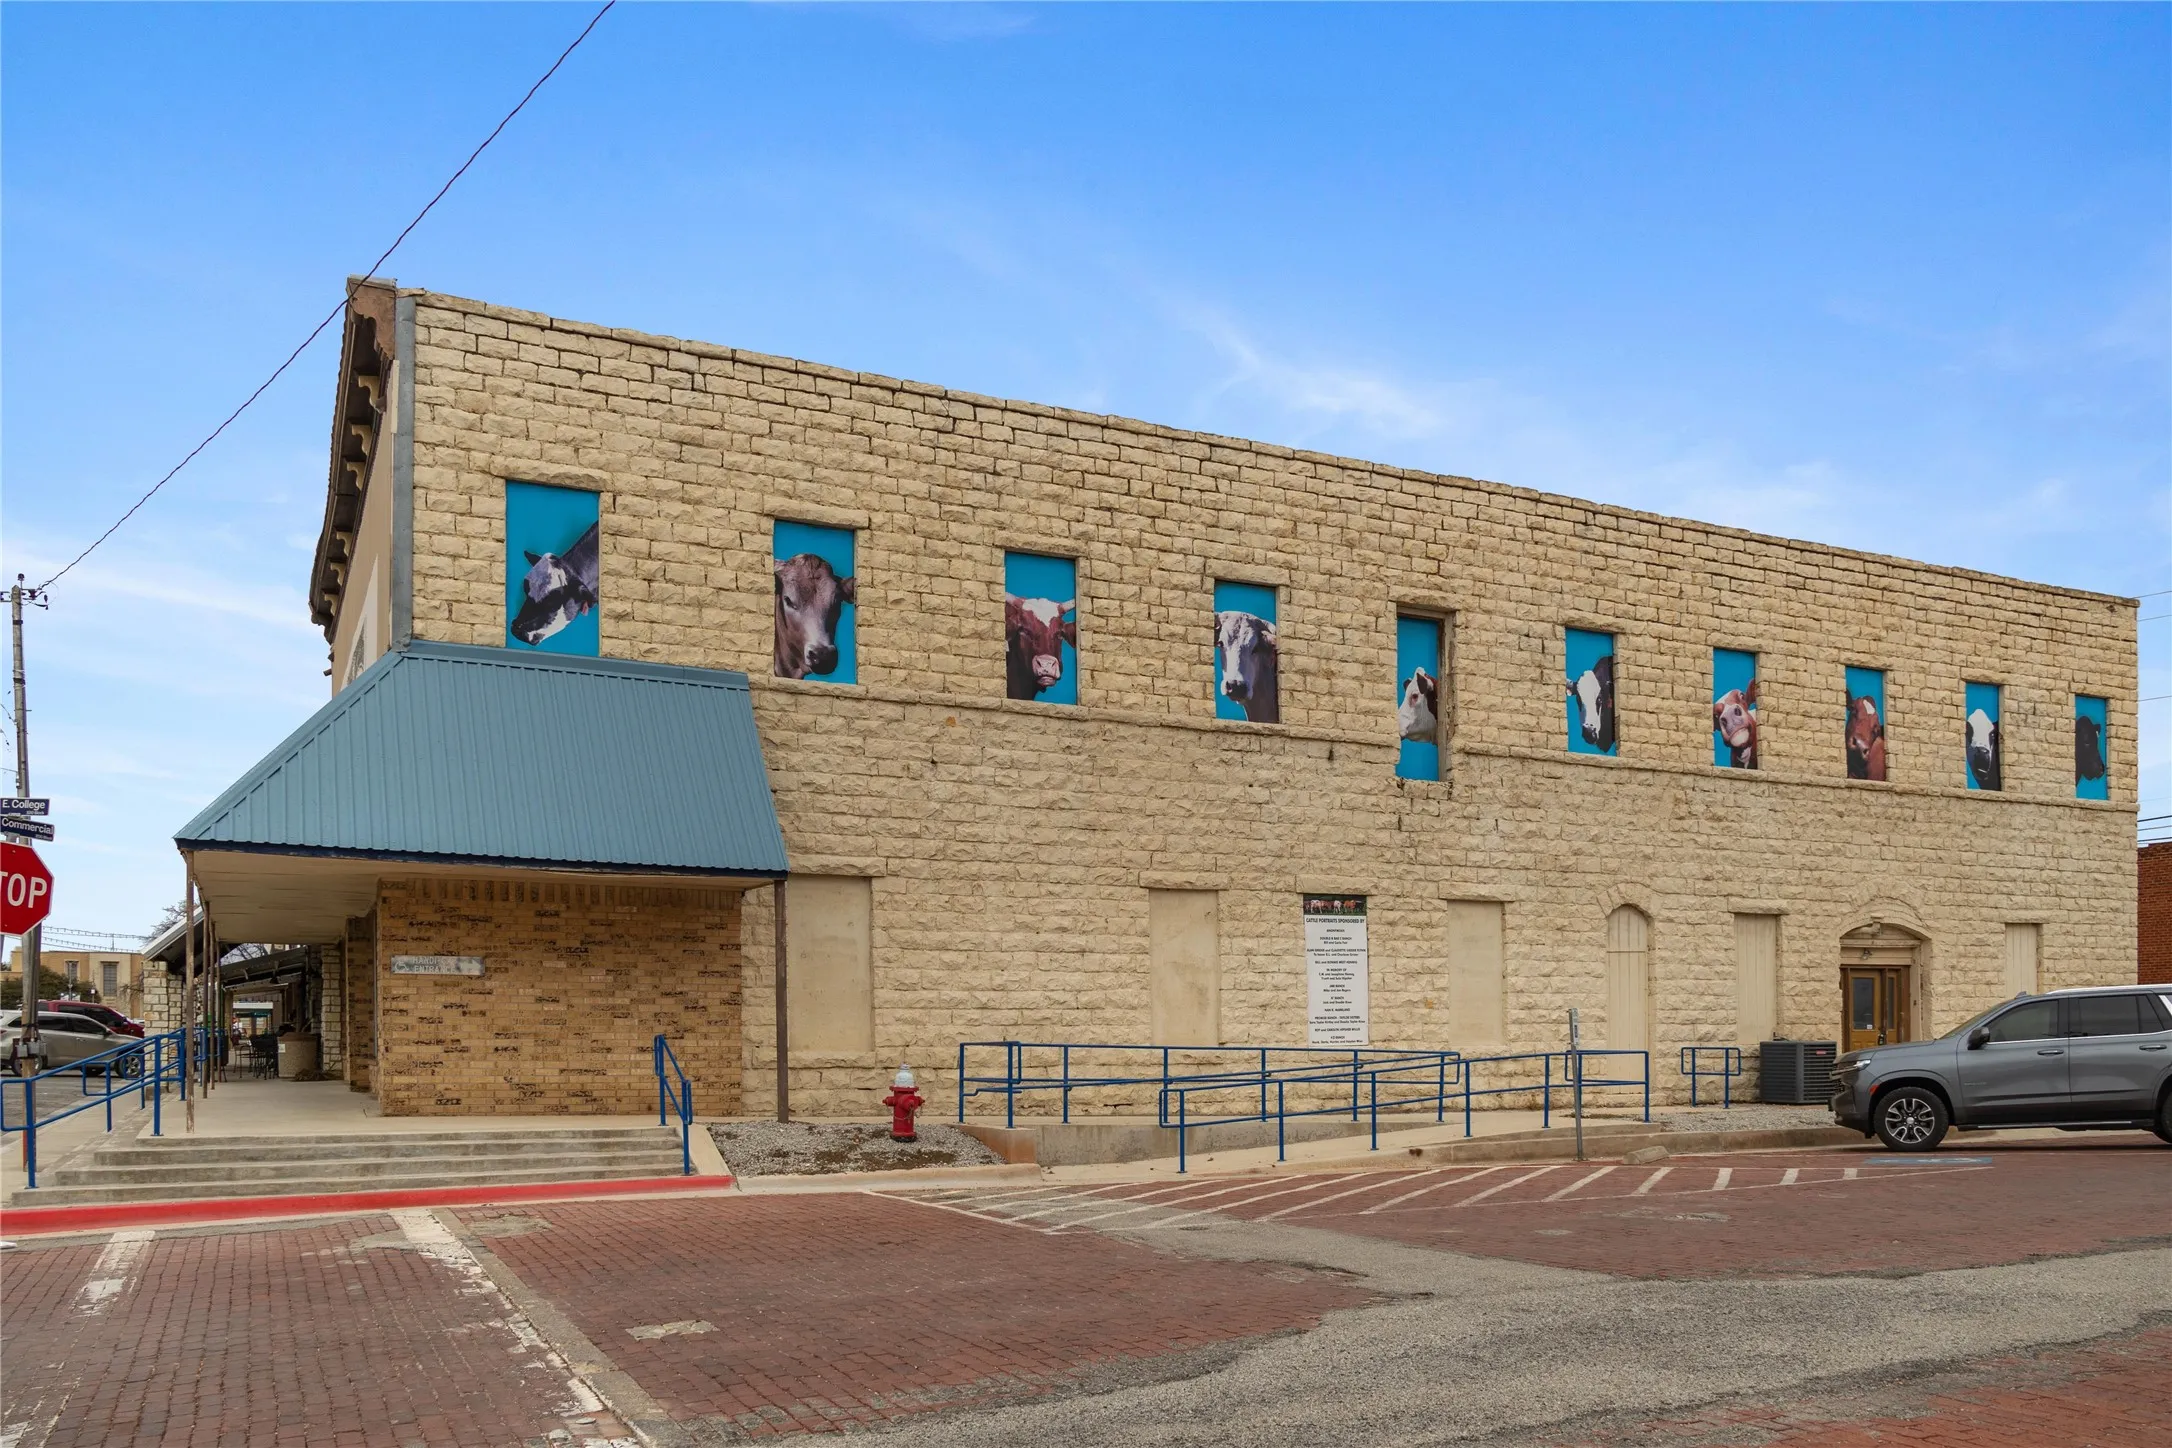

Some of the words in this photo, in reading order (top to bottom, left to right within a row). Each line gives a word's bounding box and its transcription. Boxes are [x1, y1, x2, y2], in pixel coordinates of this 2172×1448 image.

[2, 799, 10, 808] E.
[11, 799, 46, 811] College
[1, 817, 54, 835] Commercial
[0, 870, 48, 909] OP
[414, 965, 455, 973] ENTRANCE
